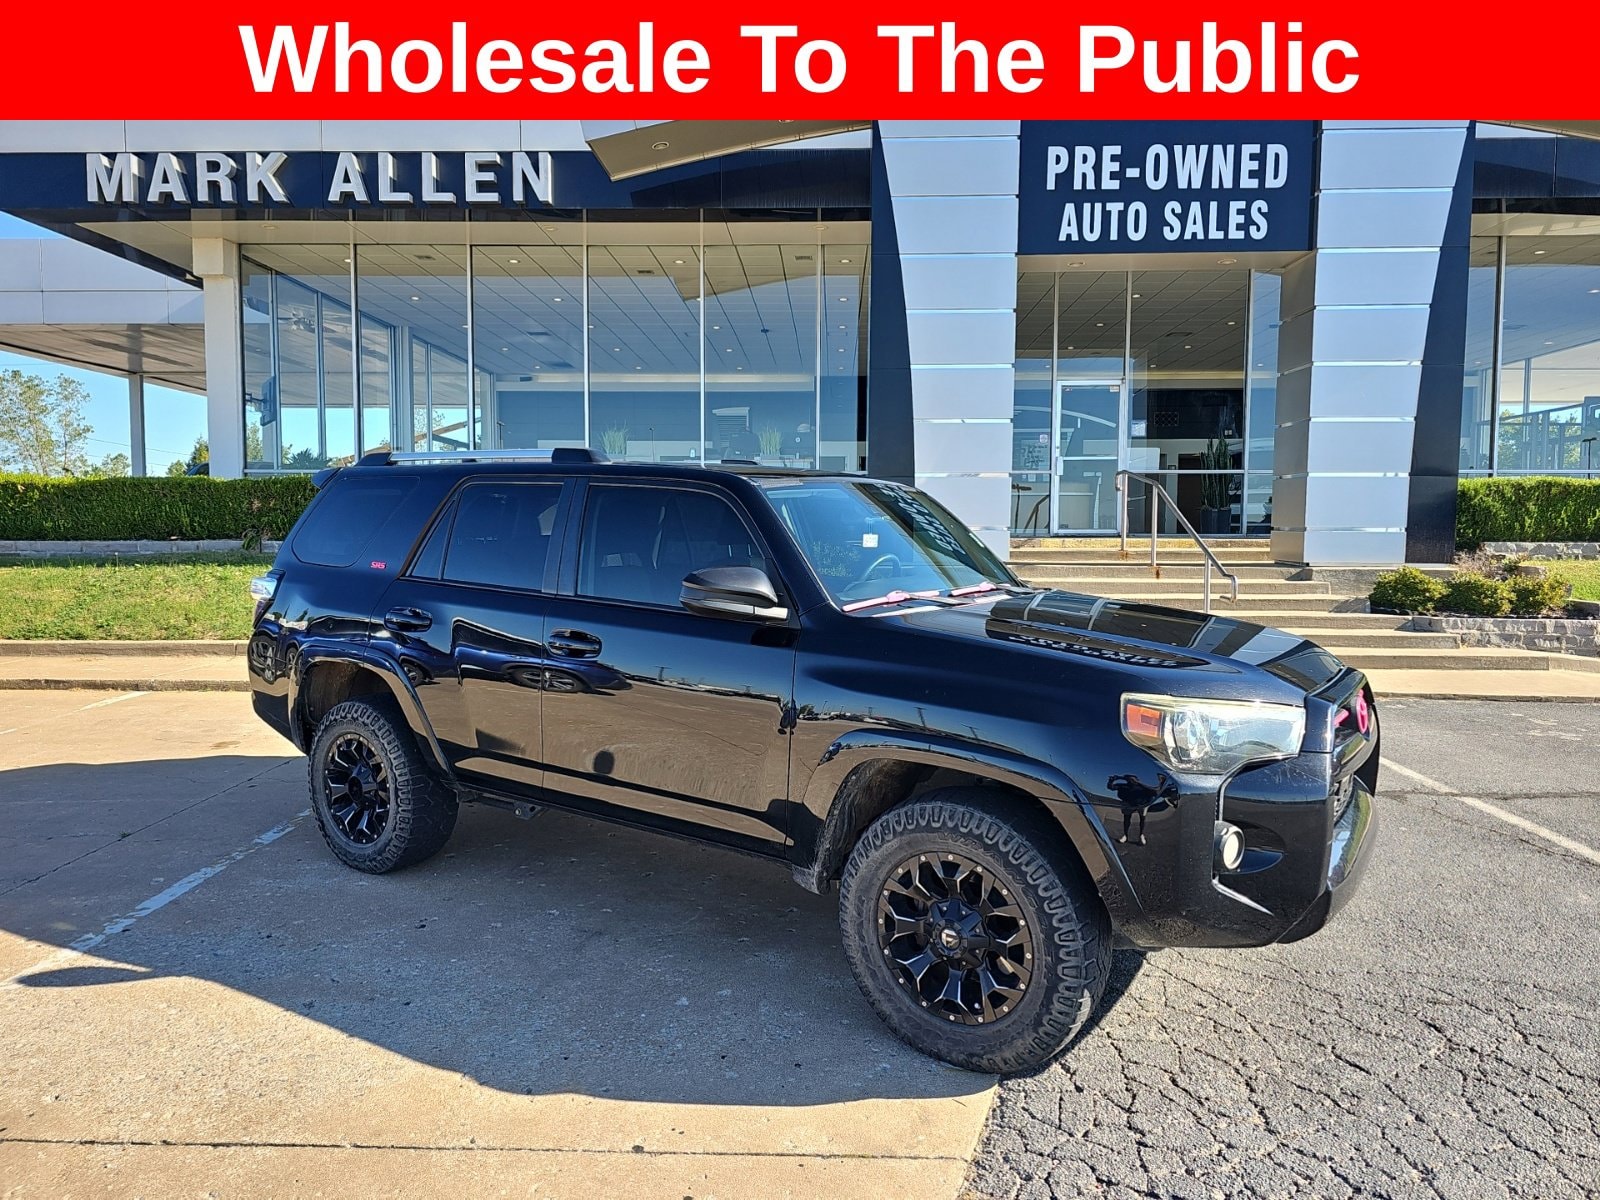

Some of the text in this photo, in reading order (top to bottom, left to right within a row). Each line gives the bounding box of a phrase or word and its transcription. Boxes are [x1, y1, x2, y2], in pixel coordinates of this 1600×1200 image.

[86, 152, 553, 205] MARK ALLEN
[1047, 144, 1288, 190] PRE-OWNED
[1059, 200, 1268, 241] AUTO SALES
